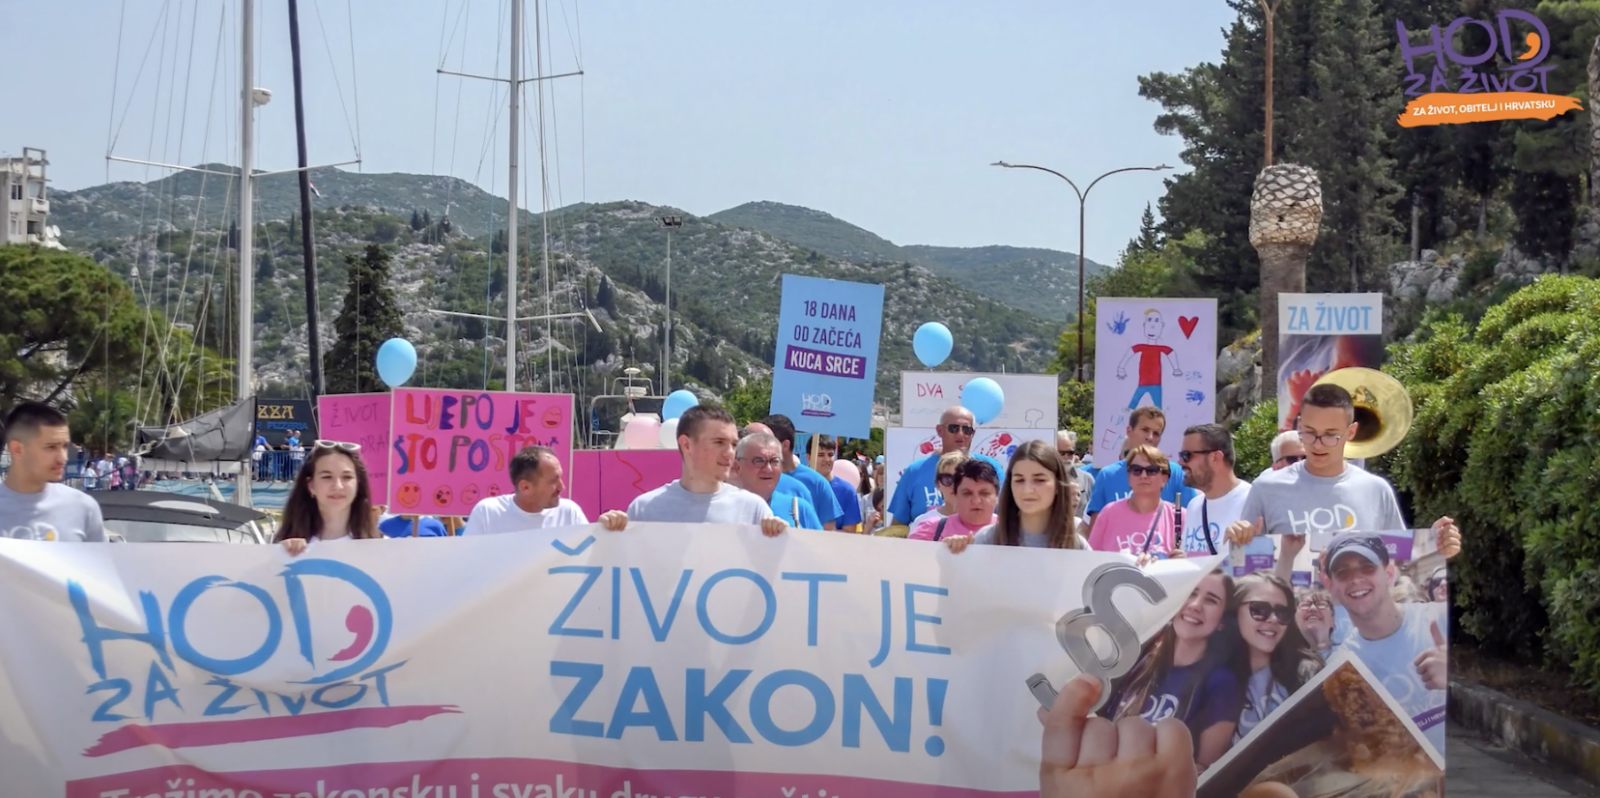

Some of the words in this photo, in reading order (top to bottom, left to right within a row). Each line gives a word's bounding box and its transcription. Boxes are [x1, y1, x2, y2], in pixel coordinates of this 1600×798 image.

[804, 300, 817, 317] 18
[821, 303, 856, 322] DANA
[1287, 306, 1309, 331] ZA
[1315, 302, 1372, 331] ŽIVOT
[794, 325, 809, 342] OD
[812, 327, 861, 349] ZAČEĆA
[790, 350, 822, 371] KUCA
[826, 355, 860, 375] SRCE
[917, 383, 943, 398] DVA
[257, 404, 294, 419] ZZA
[267, 421, 307, 430] PIZZERIA
[506, 400, 537, 434] JE
[394, 435, 438, 474] ŠTO
[1288, 504, 1357, 535] HOD
[548, 536, 848, 646] ŽIVOT
[869, 579, 951, 669] JE
[67, 558, 394, 685] HOD
[86, 661, 183, 723] ZA
[203, 659, 412, 716] ŽIVOT
[549, 660, 950, 758] ZAKON!
